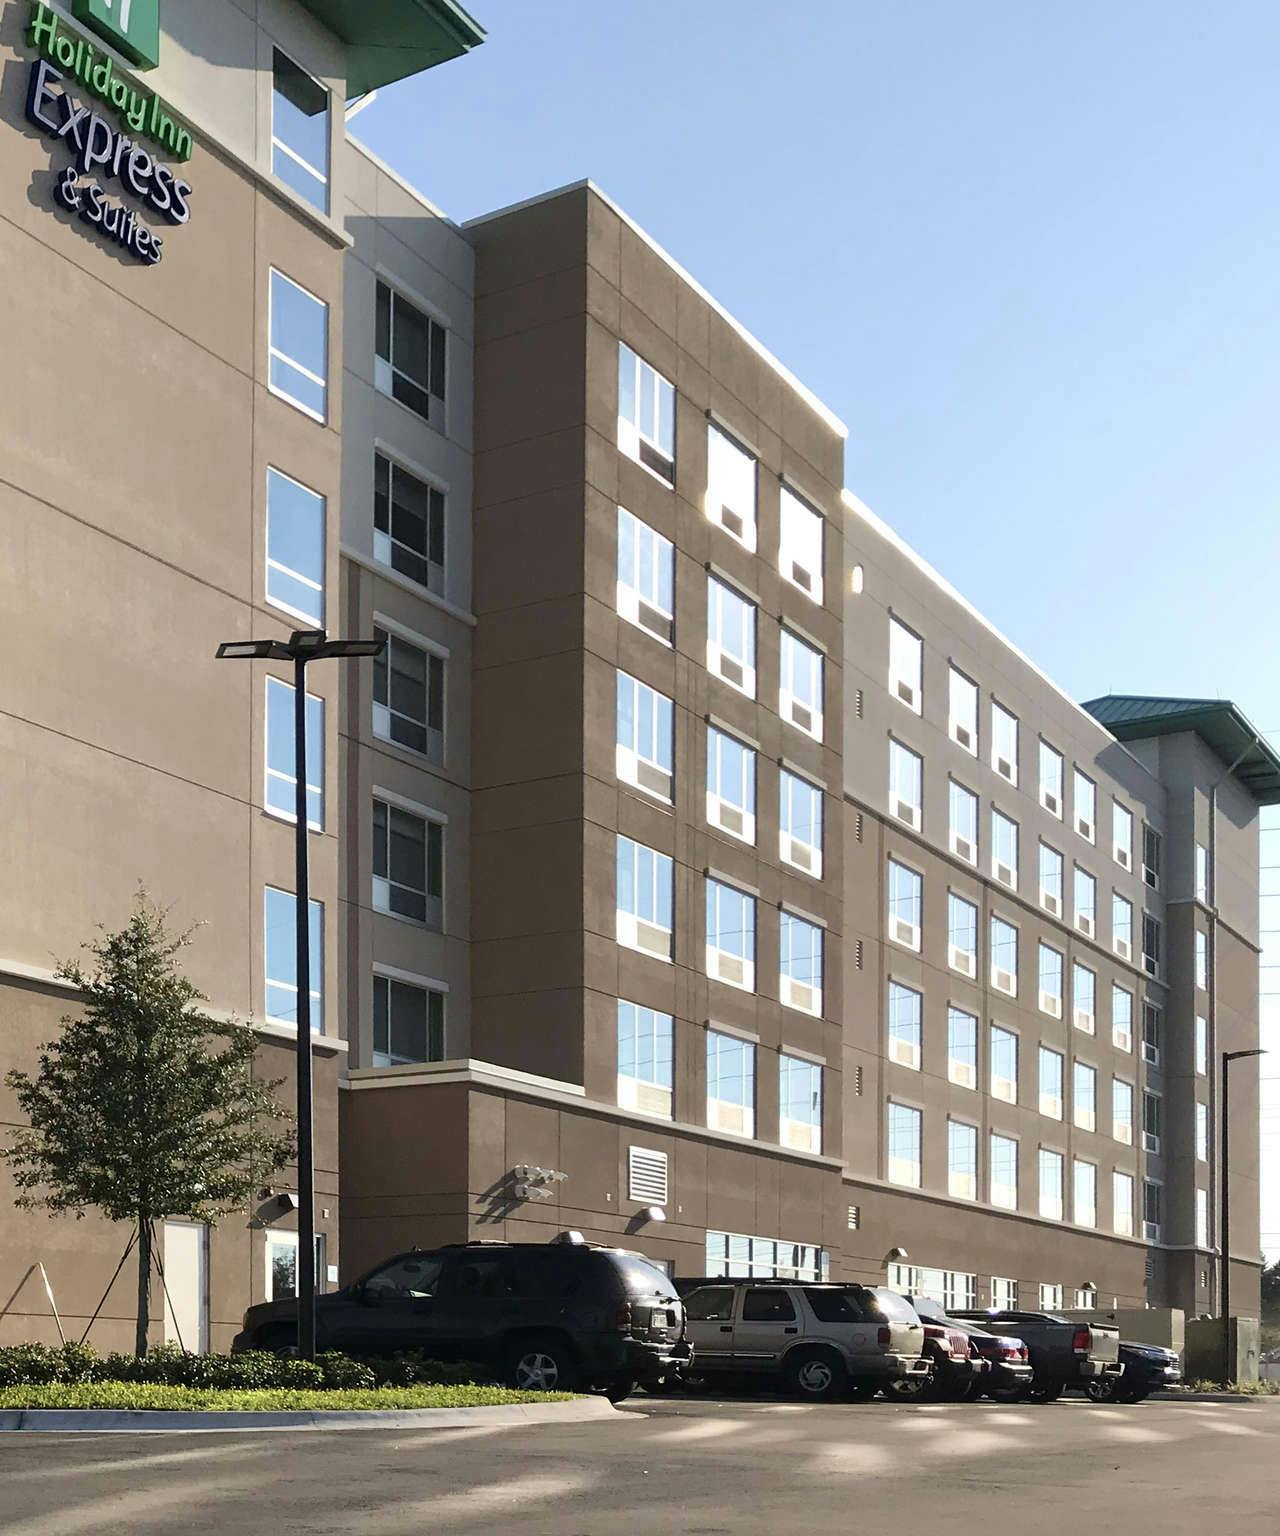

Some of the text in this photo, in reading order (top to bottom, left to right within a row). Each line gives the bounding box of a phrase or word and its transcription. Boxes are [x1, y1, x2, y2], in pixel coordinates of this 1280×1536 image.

[26, 58, 193, 225] Express
[31, 3, 193, 162] Holiday Inn
[56, 166, 163, 265] & Suites
